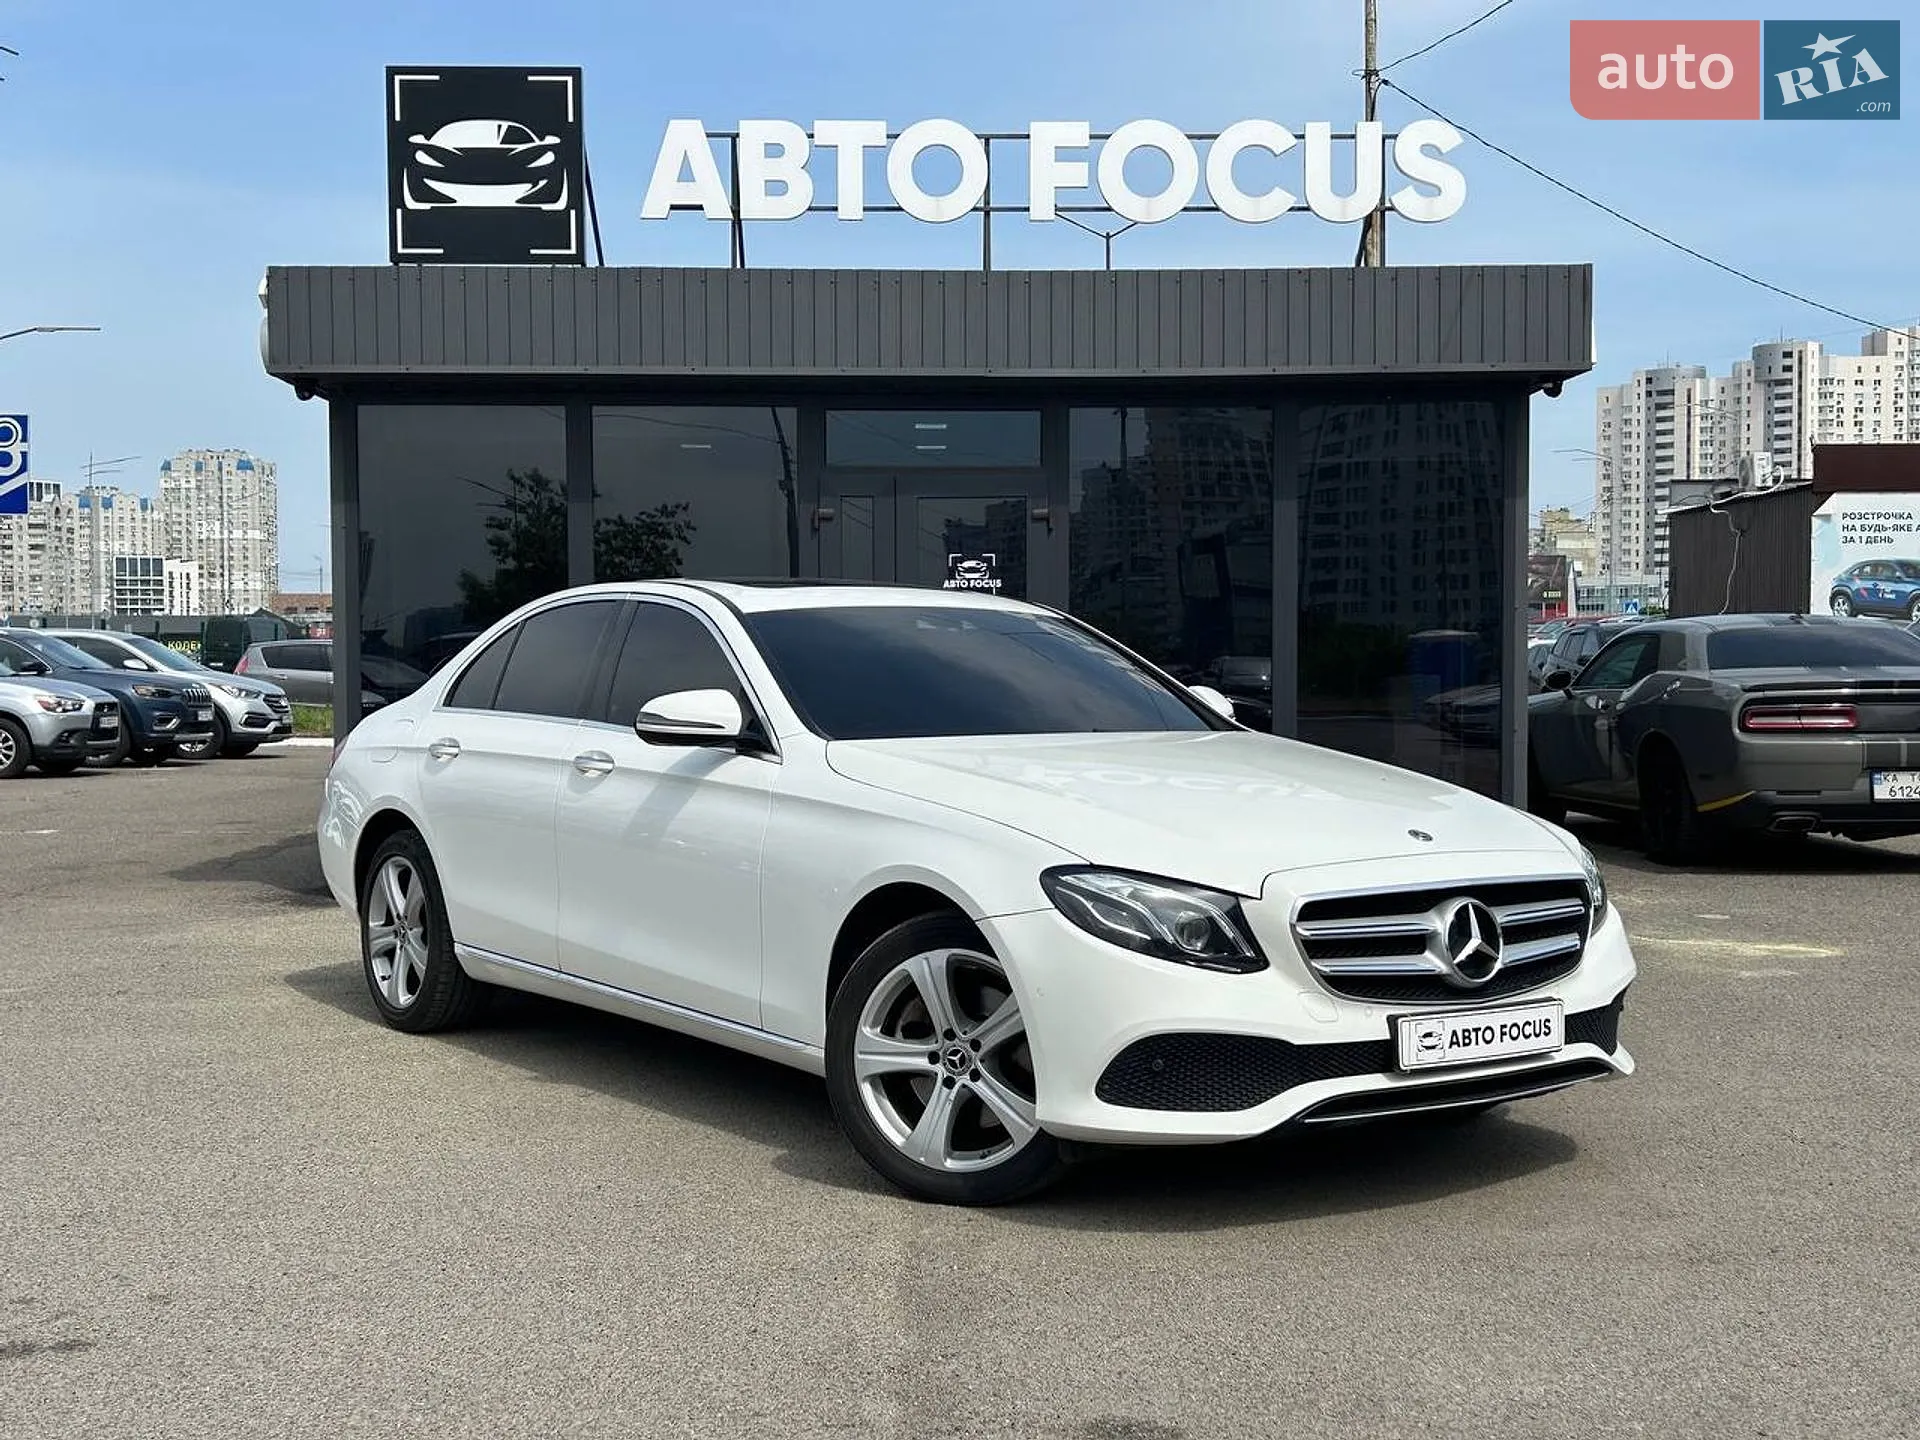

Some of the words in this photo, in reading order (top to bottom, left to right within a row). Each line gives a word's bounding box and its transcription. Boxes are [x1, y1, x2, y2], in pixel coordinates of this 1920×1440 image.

[641, 119, 989, 224] АВТО
[1028, 119, 1467, 224] FOCUS
[1842, 512, 1913, 520] РОЗСТРОЧКА
[1842, 524, 1857, 532] НА
[1860, 524, 1912, 533] БУДЬ-ЯКЕ
[1842, 536, 1855, 544] ЗА
[1865, 536, 1894, 545] ДЕНЬ
[943, 579, 967, 587] АВТО
[970, 579, 1001, 587] FOCUS
[1448, 1026, 1494, 1049] АВТО
[1500, 1018, 1552, 1043] FOCUS
